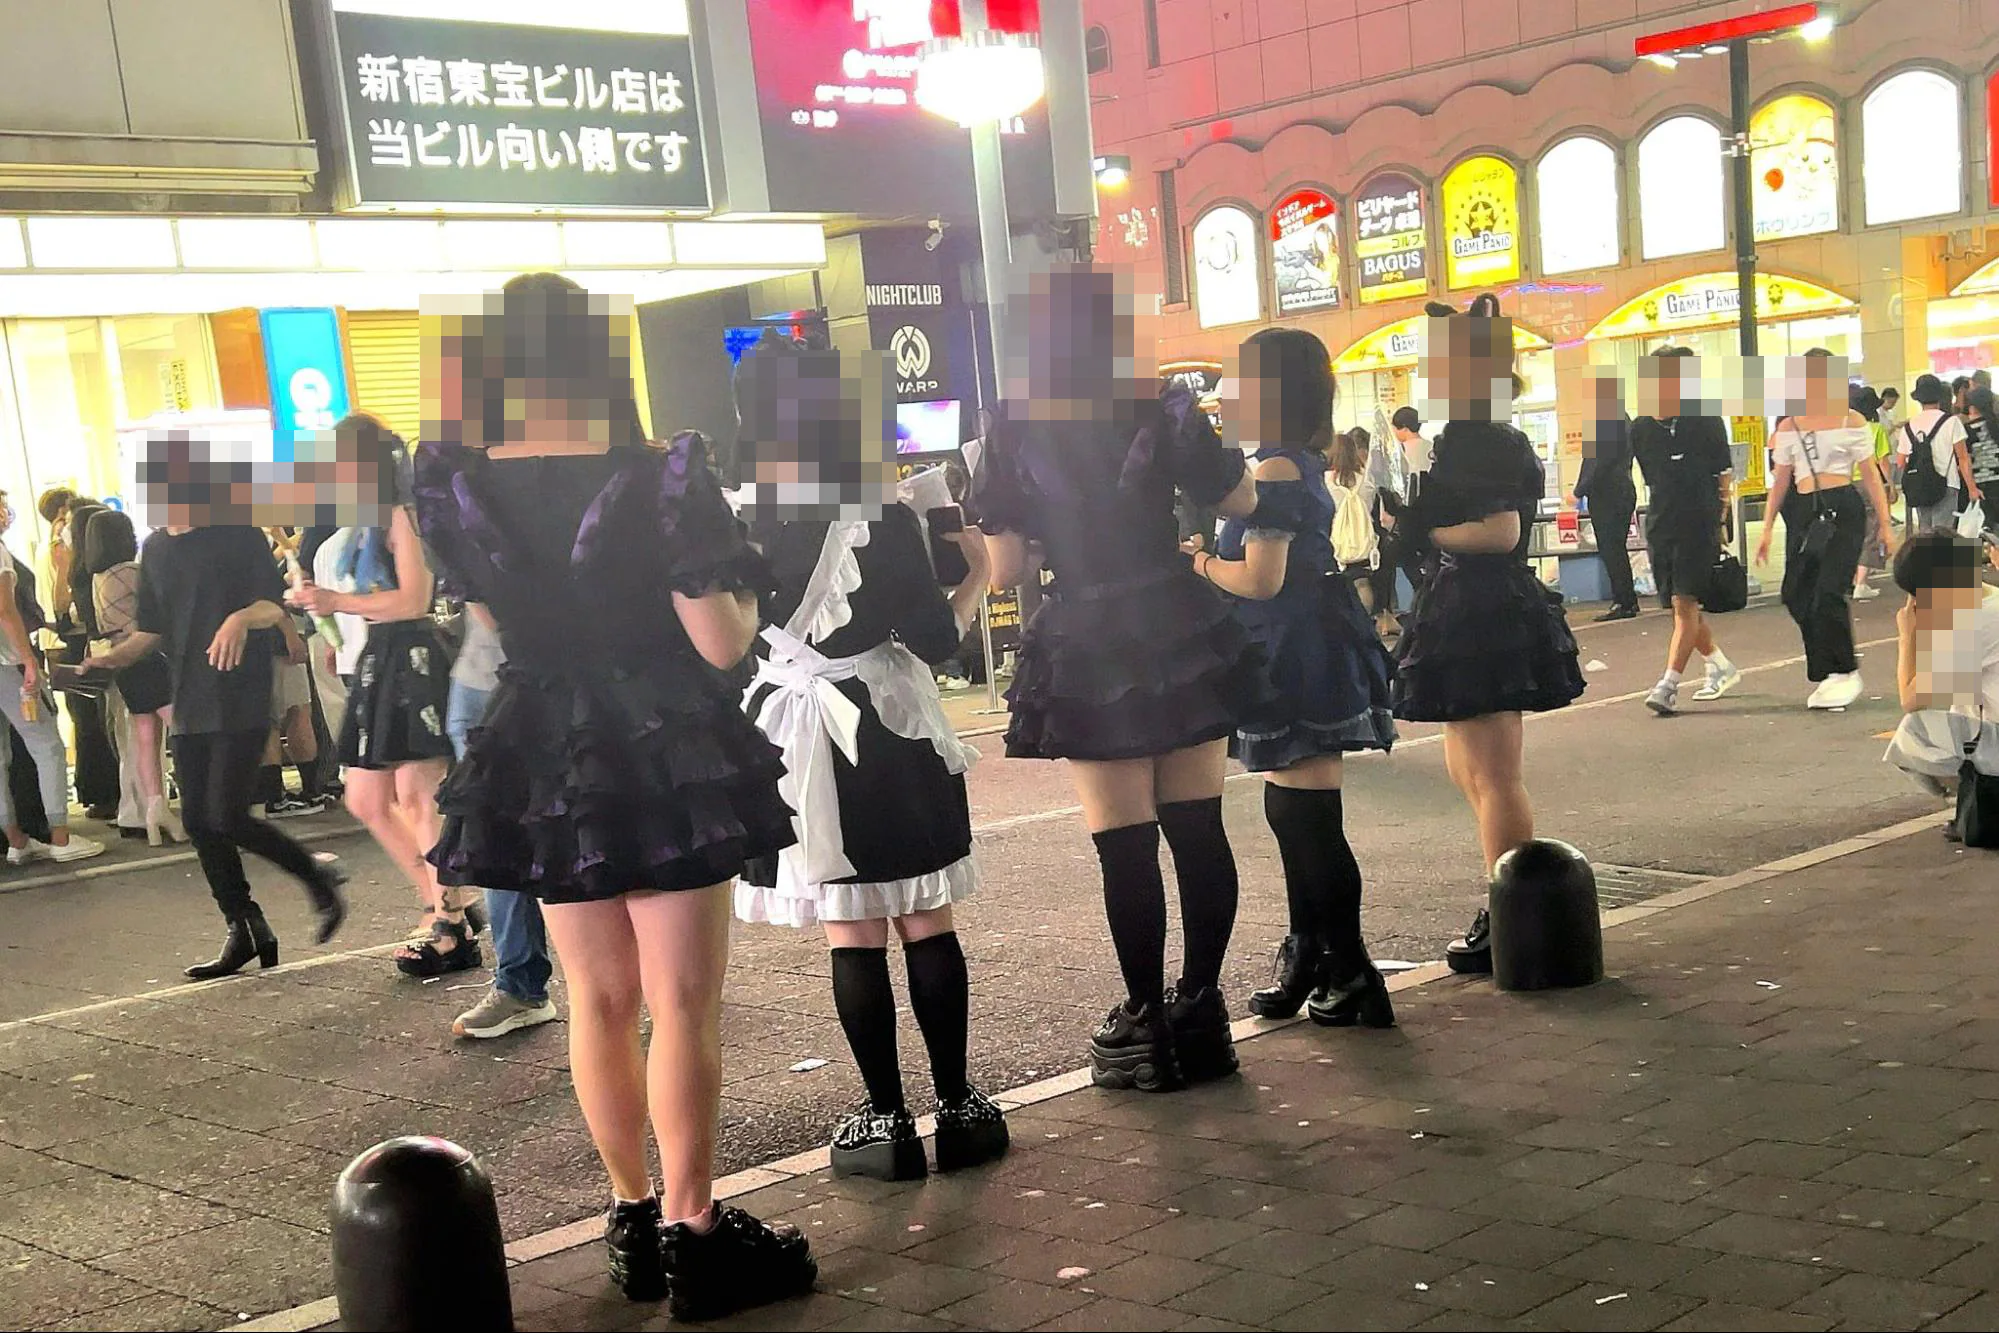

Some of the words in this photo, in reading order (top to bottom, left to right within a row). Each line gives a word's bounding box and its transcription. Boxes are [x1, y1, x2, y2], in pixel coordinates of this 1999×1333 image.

[357, 53, 684, 113] 新宿東宝ビル店は
[368, 118, 688, 172] 当ビル向い側です
[1357, 190, 1420, 219] ビリヤード
[1364, 251, 1422, 276] BAGUS
[865, 284, 943, 306] NIGHTCLUB
[1667, 294, 1701, 314] GAME
